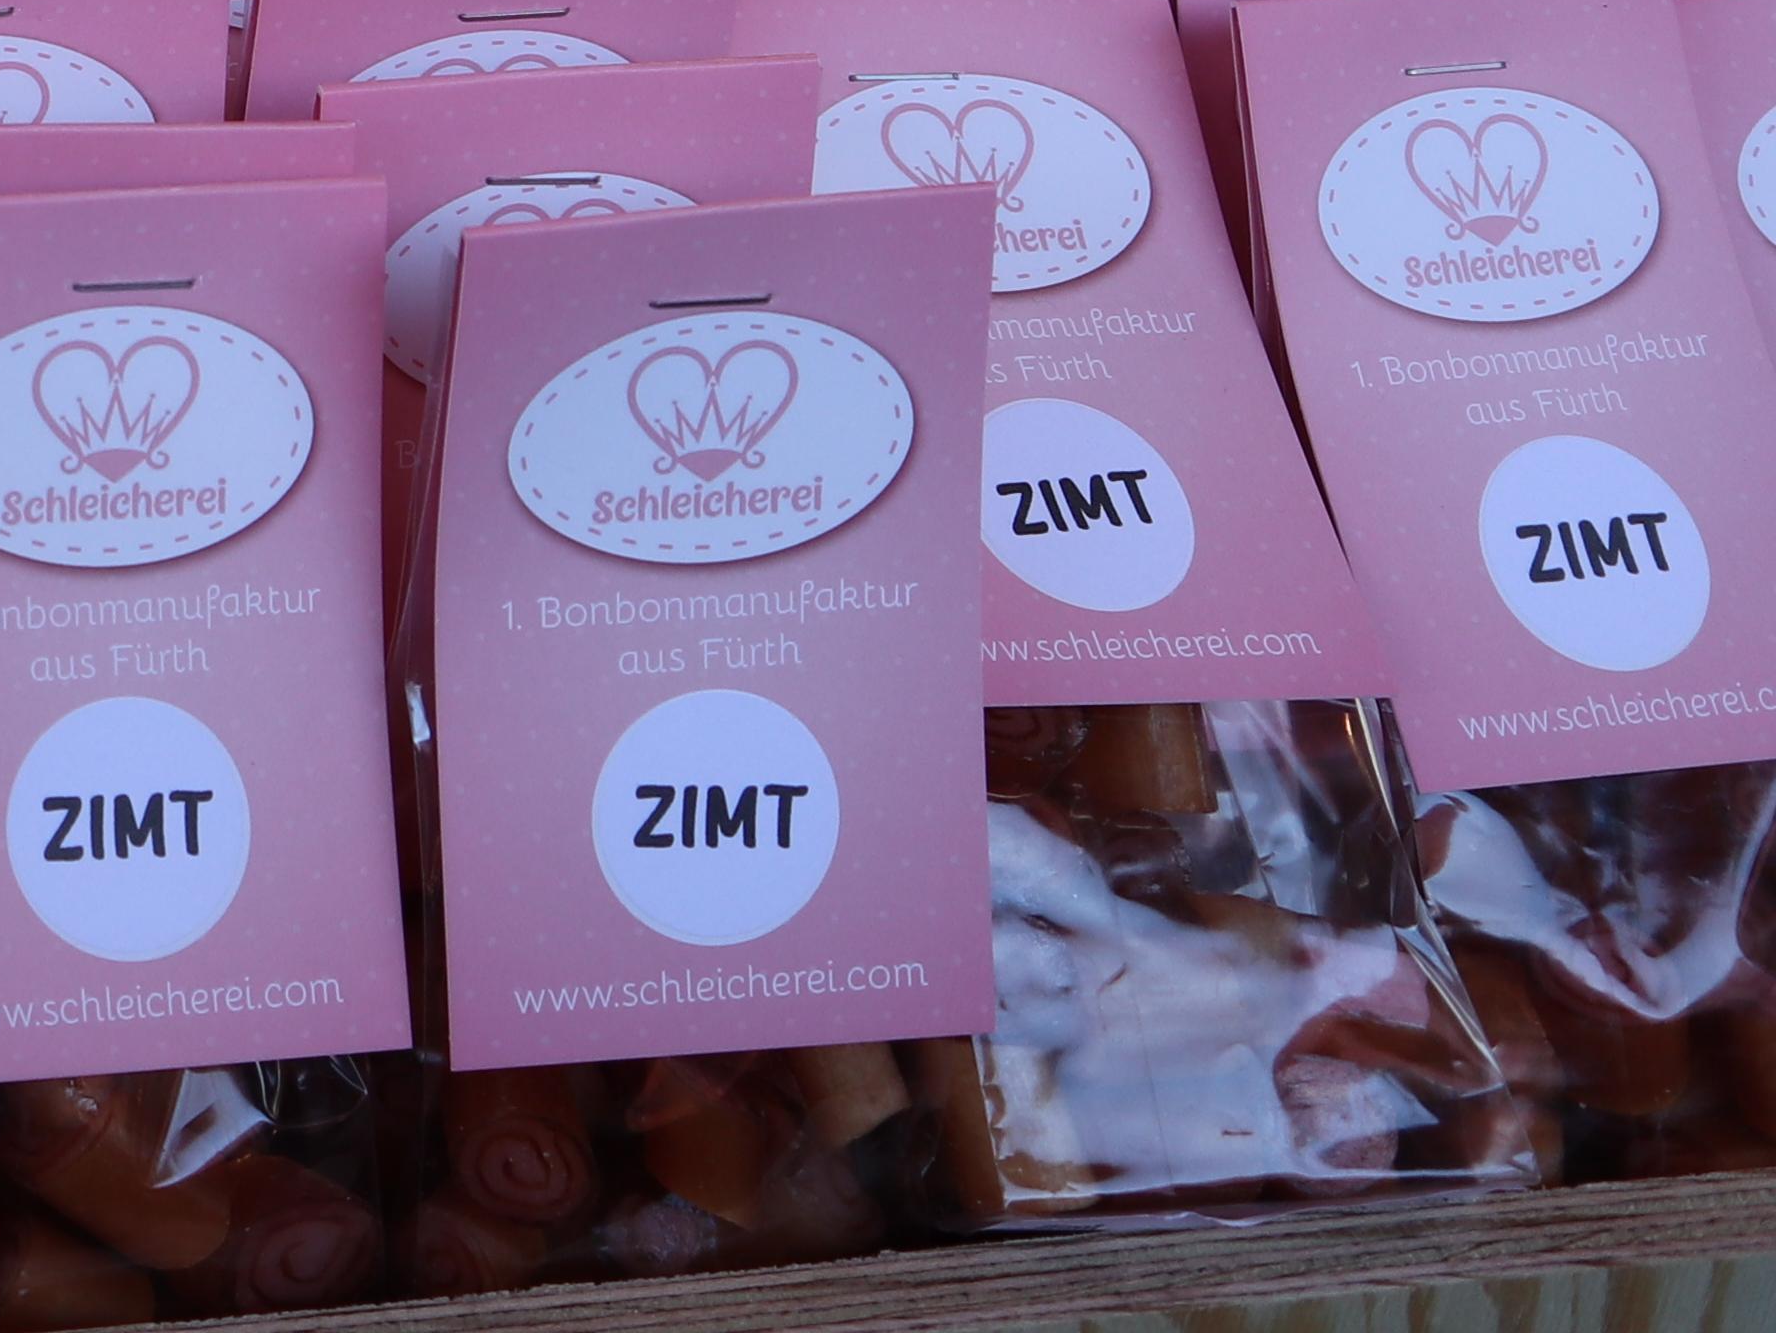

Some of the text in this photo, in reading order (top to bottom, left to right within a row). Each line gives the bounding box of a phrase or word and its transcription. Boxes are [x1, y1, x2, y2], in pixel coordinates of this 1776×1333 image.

[1403, 238, 1602, 289] Schleicherei
[1014, 352, 1112, 383] Fürth
[1350, 331, 1709, 390] 1. Bonbonmanufaktur
[1466, 383, 1628, 427] aus Fürth
[0, 477, 229, 527] Schleicherei
[591, 476, 826, 526] Schleicherei
[998, 468, 1154, 537] ZIMT
[1515, 511, 1673, 583] ZIMT
[501, 576, 920, 633] 1. Bonbonmanufaktur
[30, 640, 210, 684] aus Fürth
[617, 635, 803, 678] aus Fürth
[1458, 680, 1776, 742] www.schleicherei.c
[41, 788, 214, 863] ZIMT
[632, 783, 809, 850] ZIMT
[513, 958, 929, 1017] www.schleicherei.com
